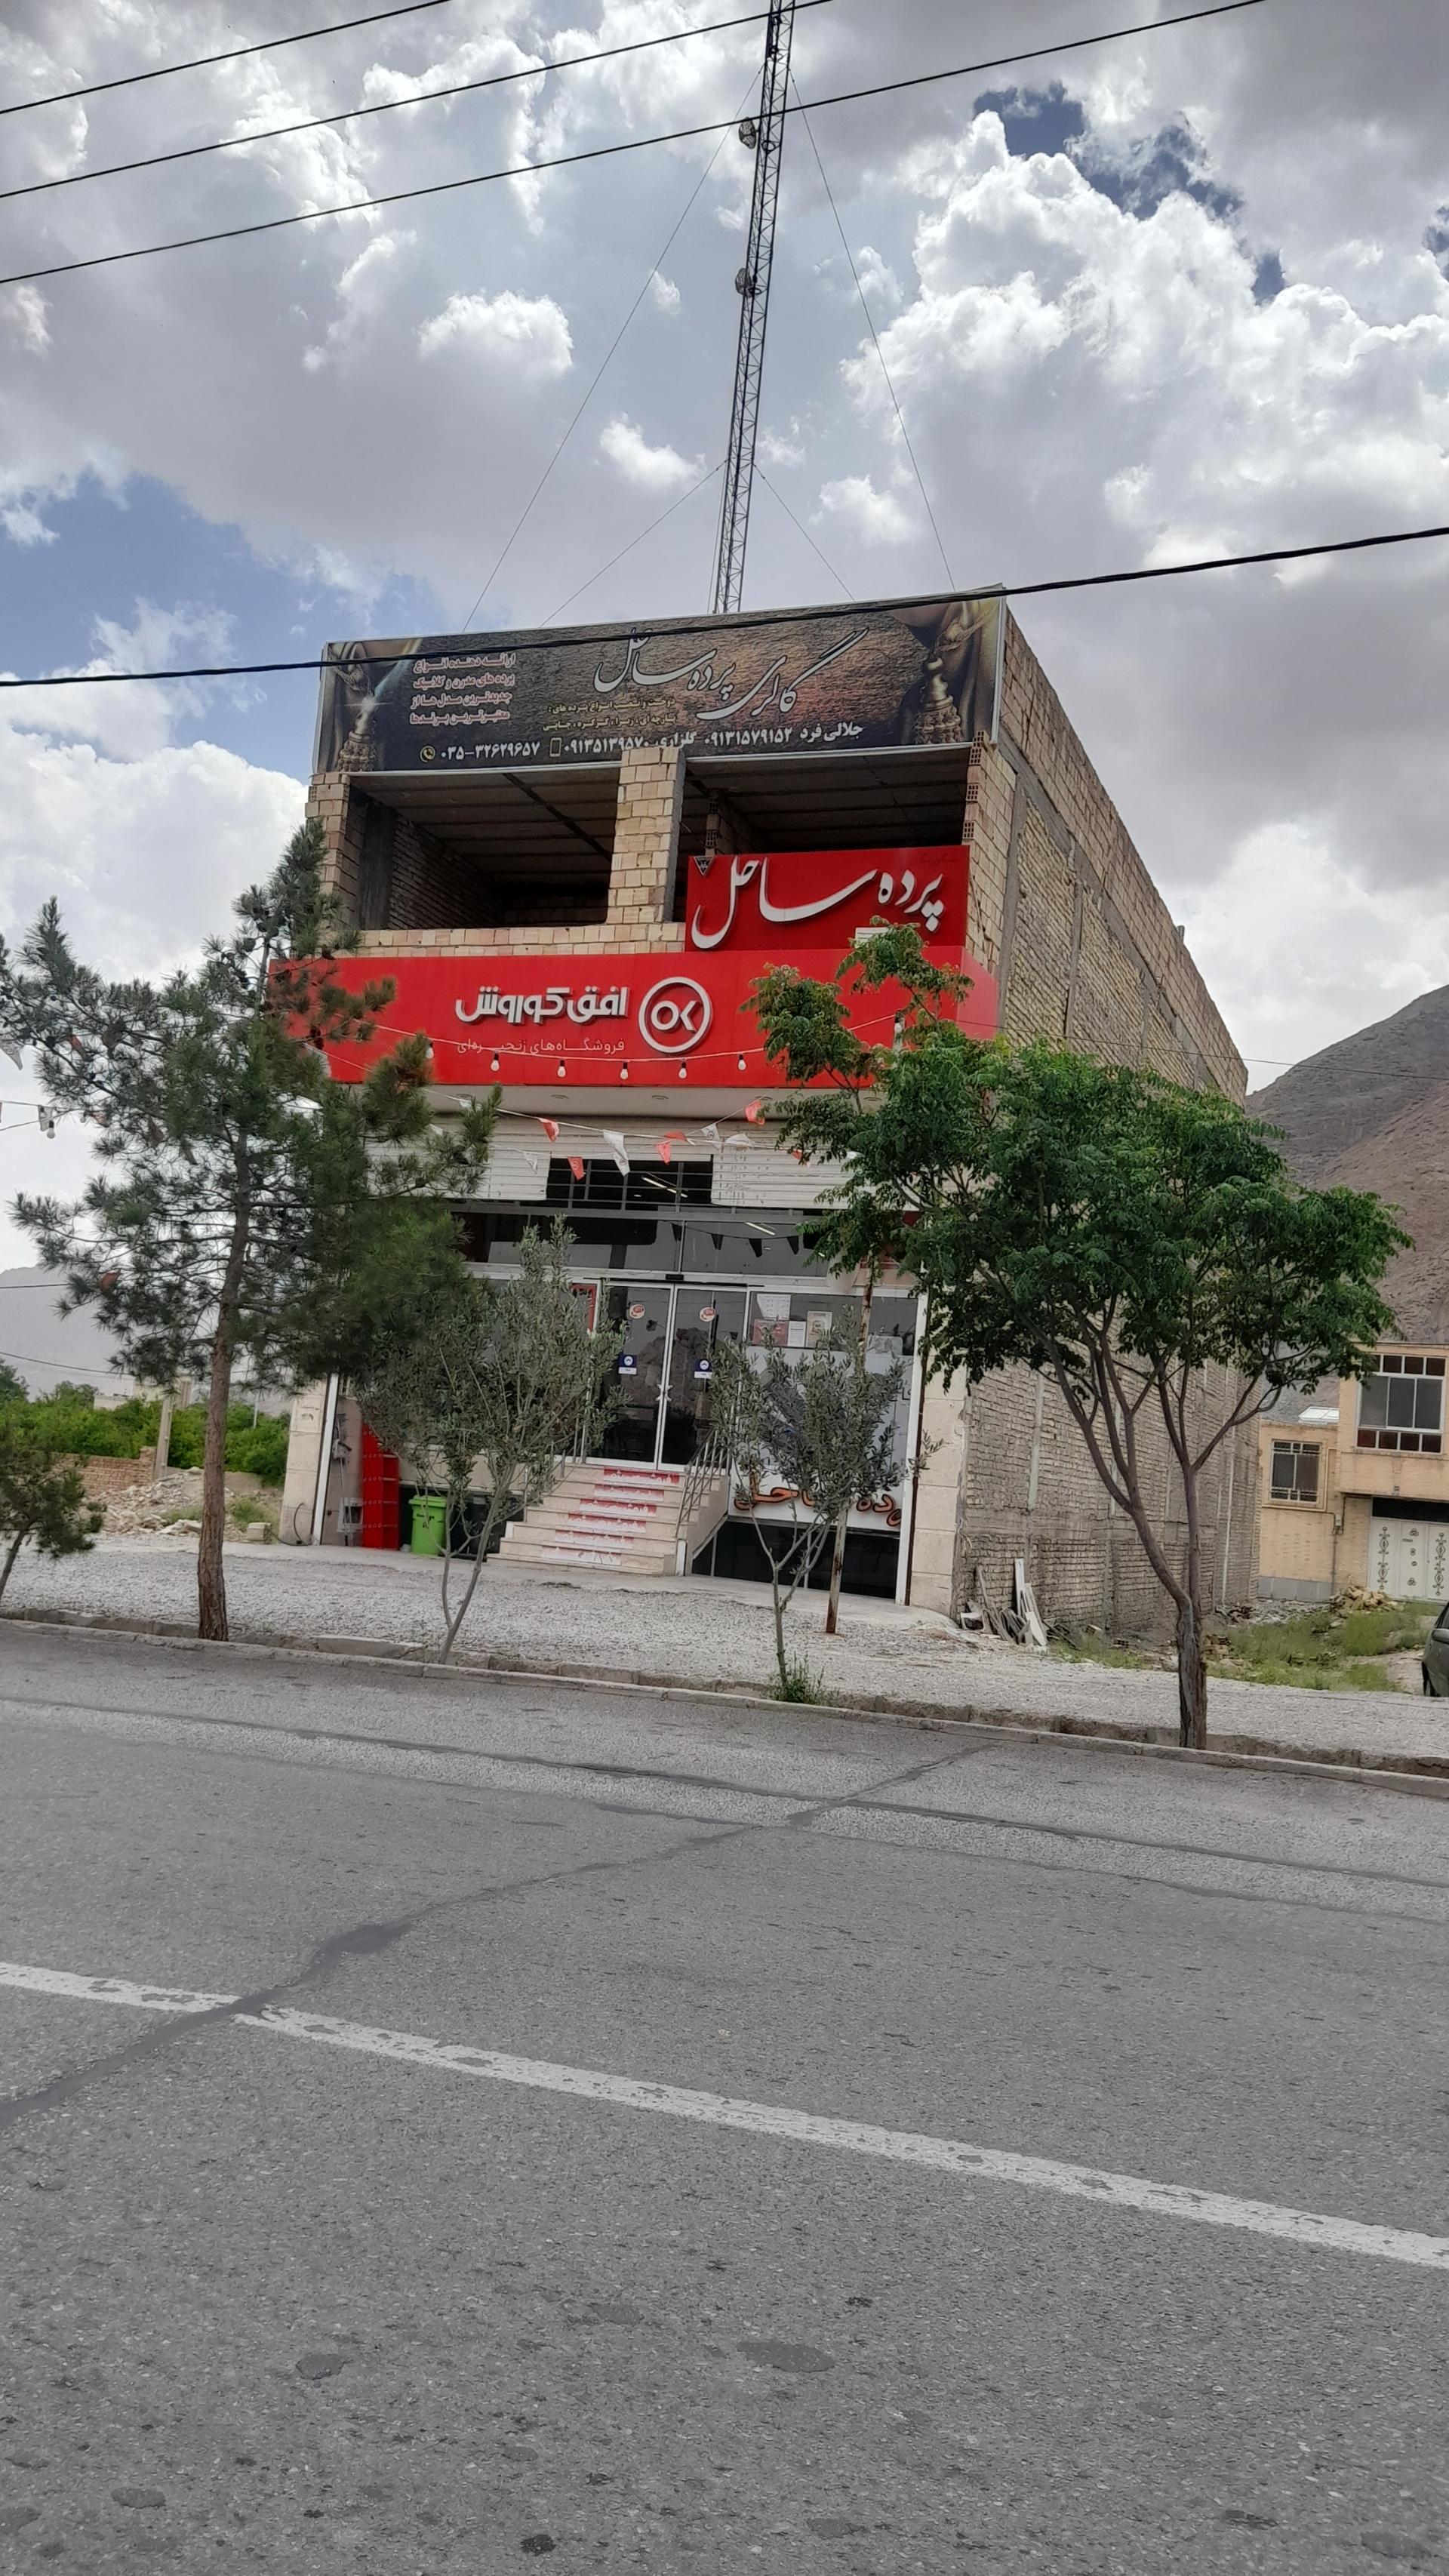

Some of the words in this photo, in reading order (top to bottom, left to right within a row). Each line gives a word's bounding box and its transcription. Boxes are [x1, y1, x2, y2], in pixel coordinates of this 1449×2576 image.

[413, 657, 449, 673] انواع
[448, 656, 481, 669] دهنده
[593, 626, 718, 693] ساحل
[696, 626, 869, 720] گالری
[413, 675, 446, 691] کلاسیک
[444, 679, 452, 690] و
[452, 675, 476, 689] مدرن
[687, 662, 736, 701] پرده
[691, 854, 878, 949] ساحل
[877, 869, 944, 932] پرده
[455, 986, 572, 1025] کوروش
[567, 986, 631, 1024] افق
[651, 999, 703, 1033] OK
